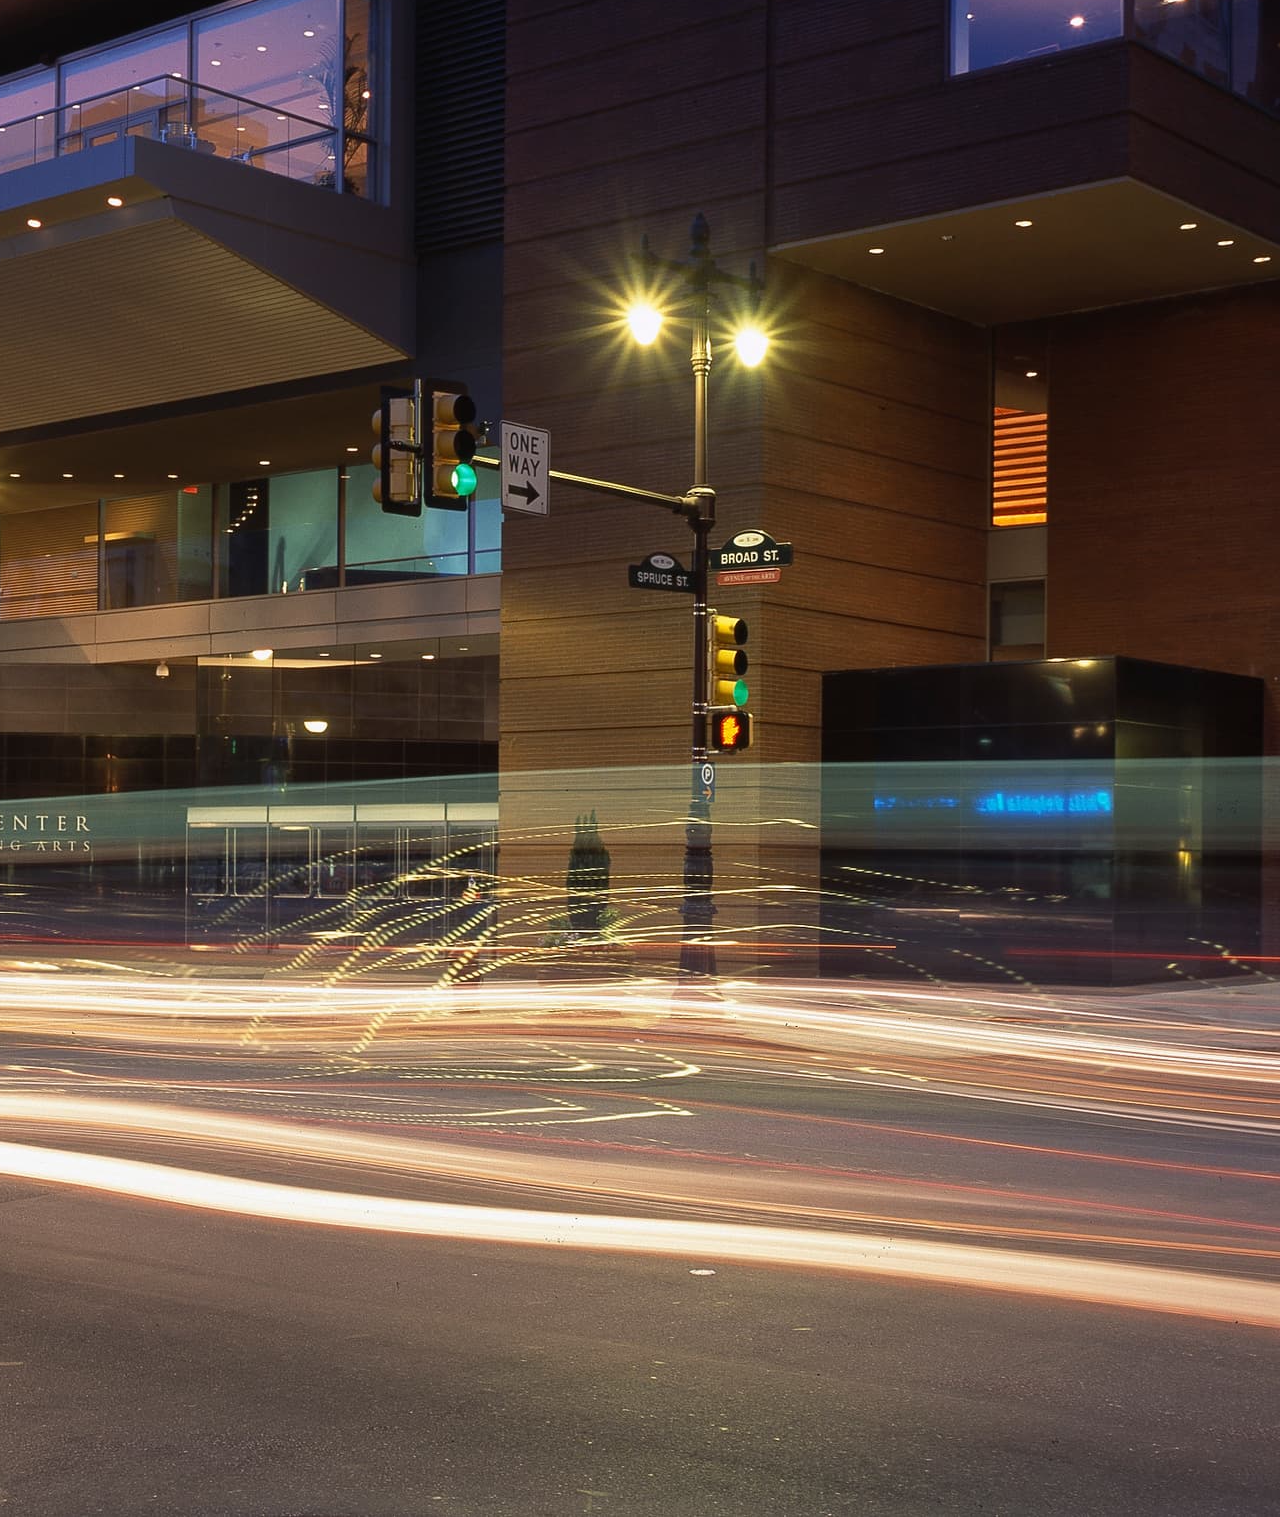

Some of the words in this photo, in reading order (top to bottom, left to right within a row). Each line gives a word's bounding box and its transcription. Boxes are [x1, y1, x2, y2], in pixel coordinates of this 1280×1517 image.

[510, 432, 539, 455] ONE
[509, 454, 541, 478] WAY
[721, 551, 759, 565] BROAD
[763, 549, 780, 562] ST.
[637, 571, 673, 586] SPRUCE
[676, 576, 689, 587] ST.
[36, 840, 91, 852] ARTS
